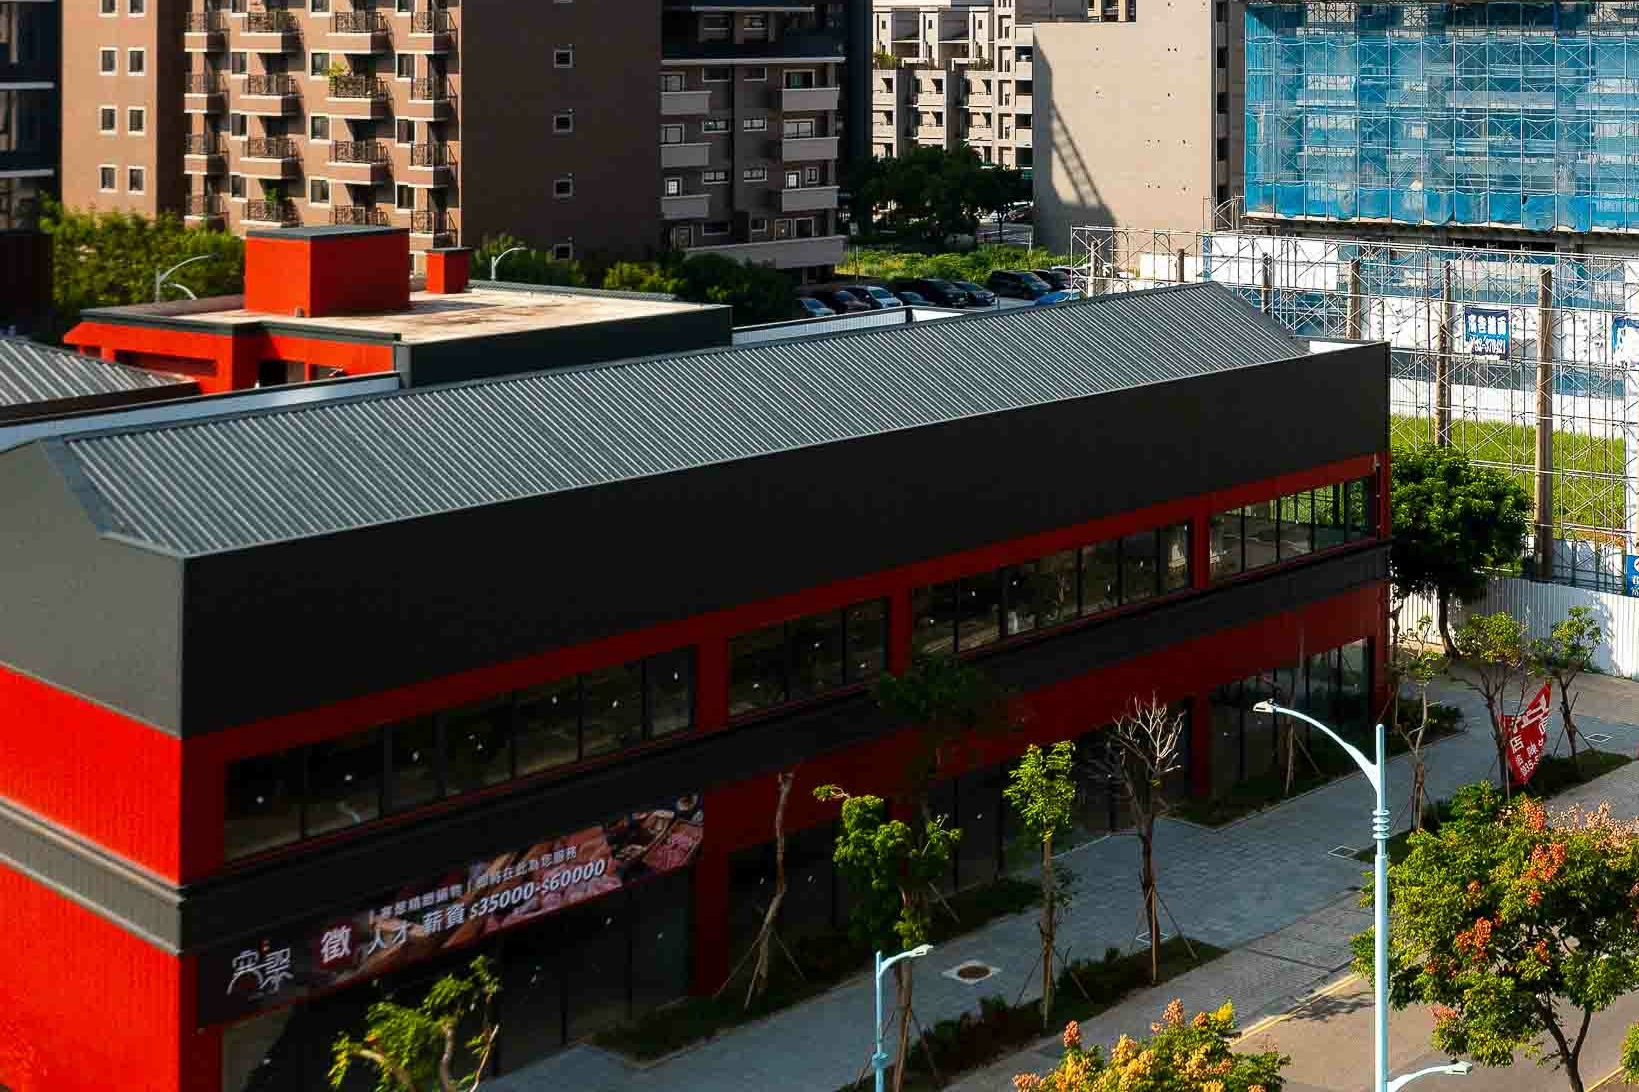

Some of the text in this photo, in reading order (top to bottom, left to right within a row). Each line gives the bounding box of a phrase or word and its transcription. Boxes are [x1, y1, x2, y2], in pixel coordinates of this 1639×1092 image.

[320, 924, 353, 965] 徵
[423, 902, 466, 936] 薪資
[469, 858, 607, 920] $35000-$60000
